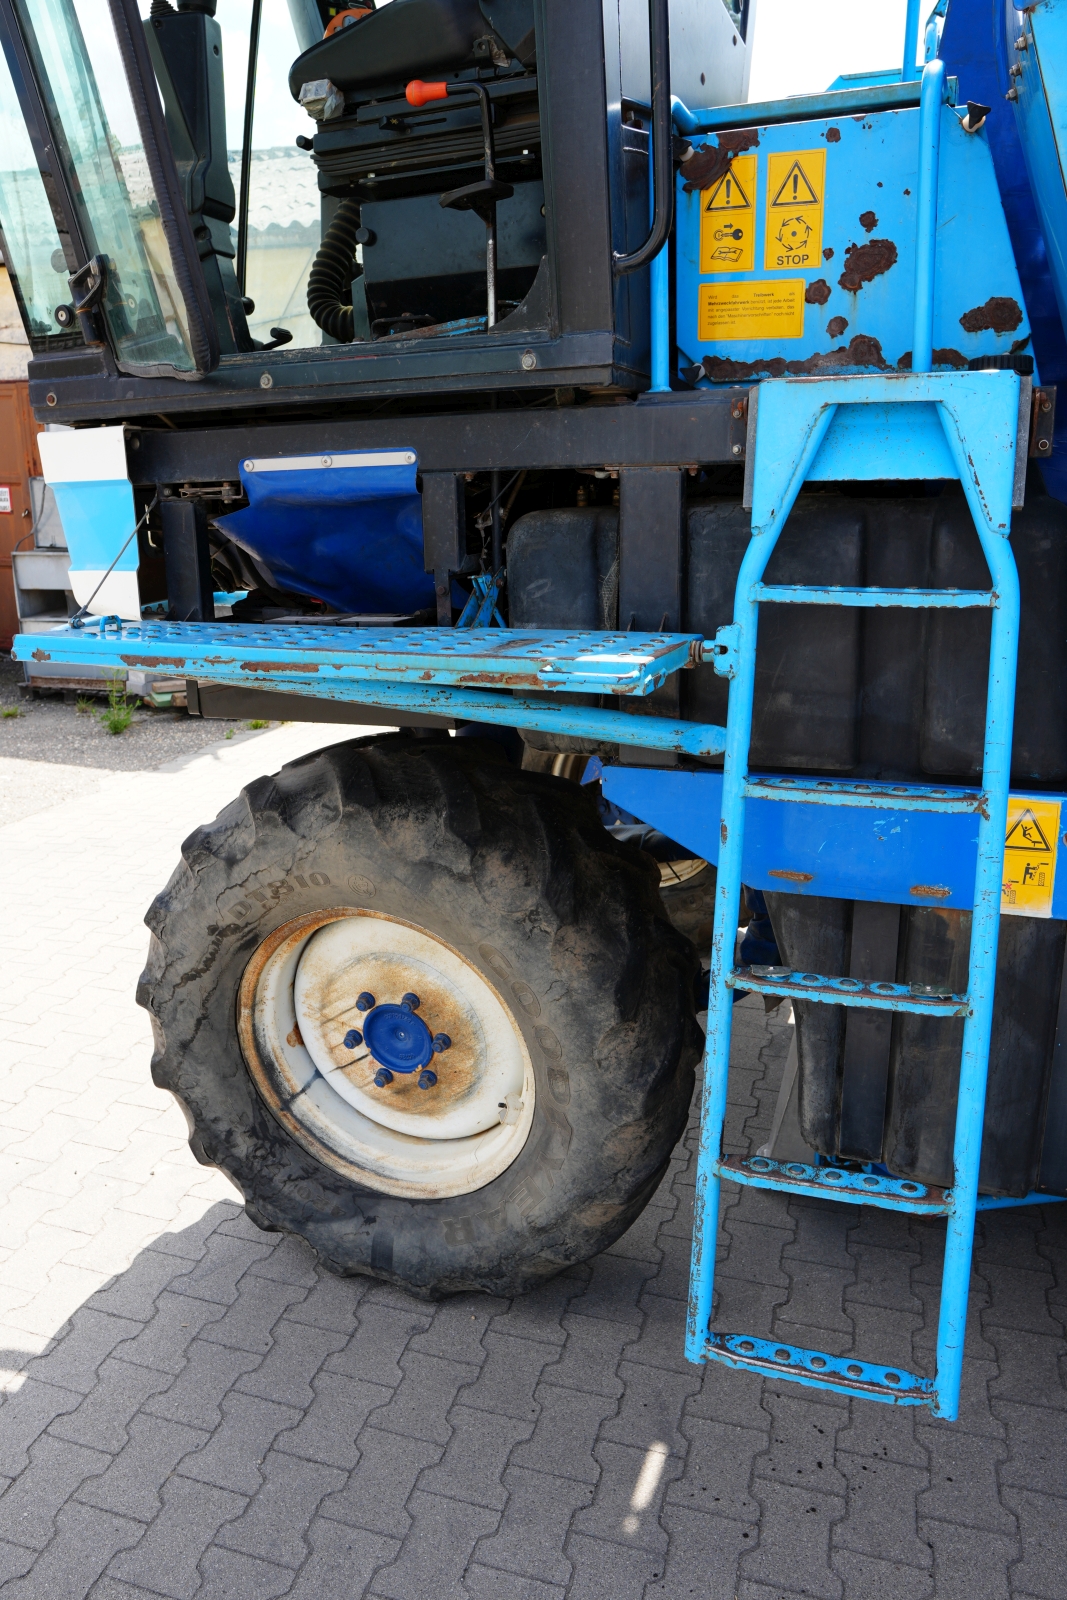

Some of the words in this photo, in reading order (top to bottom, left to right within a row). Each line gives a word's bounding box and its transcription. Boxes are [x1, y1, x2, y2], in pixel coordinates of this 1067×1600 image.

[776, 254, 809, 266] STOP
[227, 871, 331, 922] DT810
[441, 943, 573, 1247] GOODYEAR
